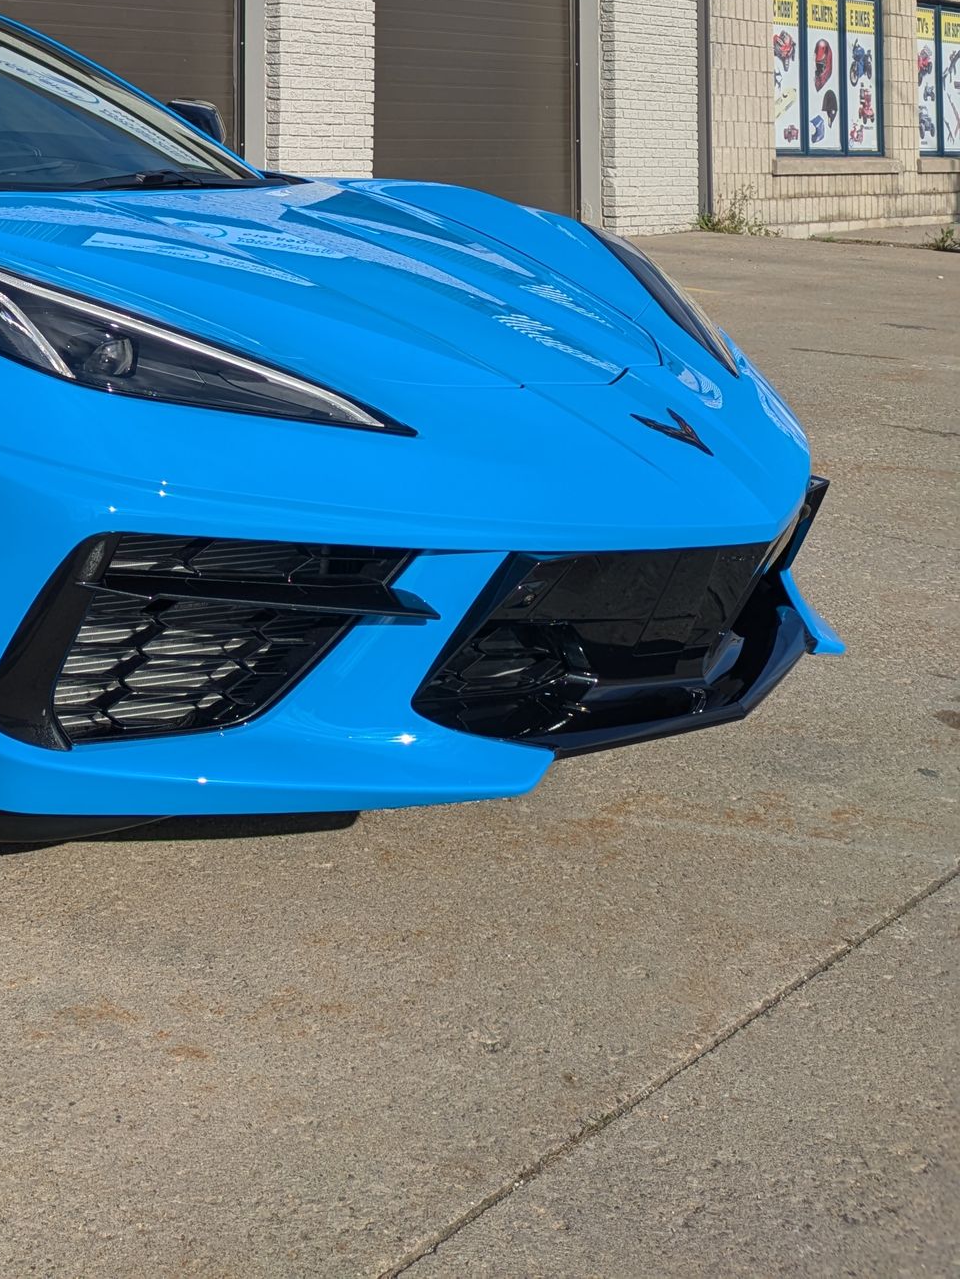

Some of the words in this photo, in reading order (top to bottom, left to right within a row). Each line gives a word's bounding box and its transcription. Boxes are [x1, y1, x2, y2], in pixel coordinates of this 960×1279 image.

[811, 4, 834, 24] HELMETS
[850, 9, 855, 27] E
[855, 10, 871, 28] BIKES
